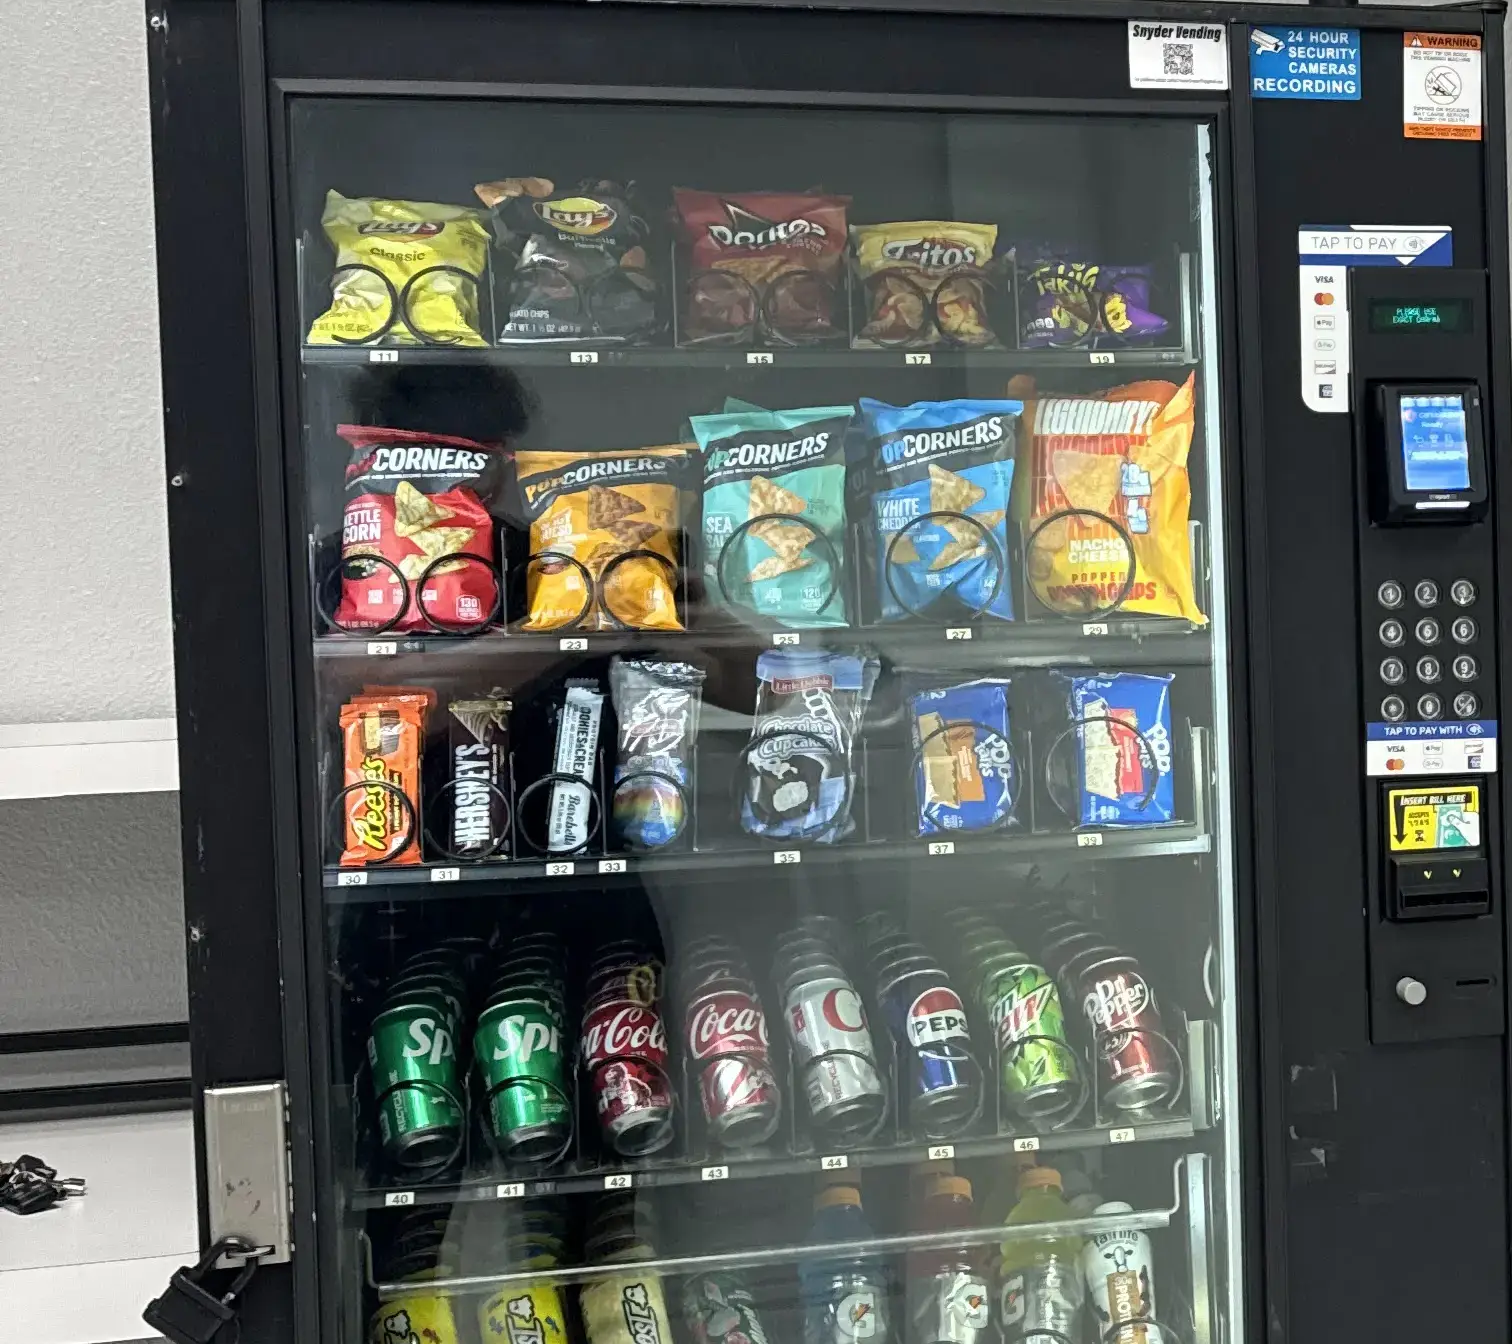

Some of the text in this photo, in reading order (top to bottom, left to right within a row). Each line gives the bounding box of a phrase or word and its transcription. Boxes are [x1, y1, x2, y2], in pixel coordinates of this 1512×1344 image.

[1133, 24, 1222, 42] Snyder Vending
[1288, 31, 1349, 44] 24 HOUR
[1428, 36, 1478, 48] WARNING
[1288, 47, 1357, 59] SECURITY
[1288, 62, 1357, 75] CAMERAS
[1254, 78, 1356, 93] RECORDING
[708, 219, 826, 246] Doritos
[1311, 236, 1397, 249] TAP TO PAY
[370, 247, 426, 262] Classic
[378, 353, 392, 361] 11
[577, 354, 592, 364] 13
[754, 356, 768, 364] 15
[912, 356, 926, 364] 17
[1096, 356, 1110, 364] 19
[882, 417, 1003, 464] OPCORNERS
[877, 498, 921, 517] WHITE
[706, 516, 733, 534] SEA
[343, 523, 381, 545] CORN
[1070, 539, 1125, 551] NACHO
[1386, 588, 1394, 601] 1
[1423, 587, 1433, 600] 2
[460, 598, 478, 608] 130
[952, 631, 966, 640] 27
[1089, 627, 1102, 635] 29
[1387, 626, 1396, 640] 4
[1460, 624, 1468, 637] 6
[567, 641, 582, 650] 23
[780, 637, 794, 645] 25
[376, 646, 391, 654] 21
[1388, 663, 1396, 677] 7
[1425, 662, 1432, 675] 8
[1460, 660, 1467, 673] 9
[1384, 725, 1463, 736] TAP TO PAY WITH
[454, 743, 491, 843] HERSHEY'S
[351, 755, 387, 851] Reese's
[1400, 794, 1466, 806] INSERT BILL HERE
[564, 794, 581, 846] Barebells
[1084, 837, 1097, 846] 39
[935, 845, 948, 854] 37
[780, 854, 795, 863] 35
[553, 865, 568, 874] 32
[605, 863, 620, 871] 33
[346, 875, 361, 884] 30
[440, 871, 453, 879] 31
[1096, 976, 1127, 1000] Dr
[1084, 988, 1144, 1029] Pepper
[1115, 1132, 1130, 1141] 47
[1019, 1141, 1034, 1150] 46
[934, 1148, 949, 1158] 45
[827, 1158, 842, 1167] 44
[708, 1169, 723, 1179] 43
[610, 1177, 626, 1186] 42
[504, 1186, 518, 1195] 41
[391, 1194, 408, 1204] 40
[952, 1284, 989, 1329] G
[837, 1293, 877, 1338] G
